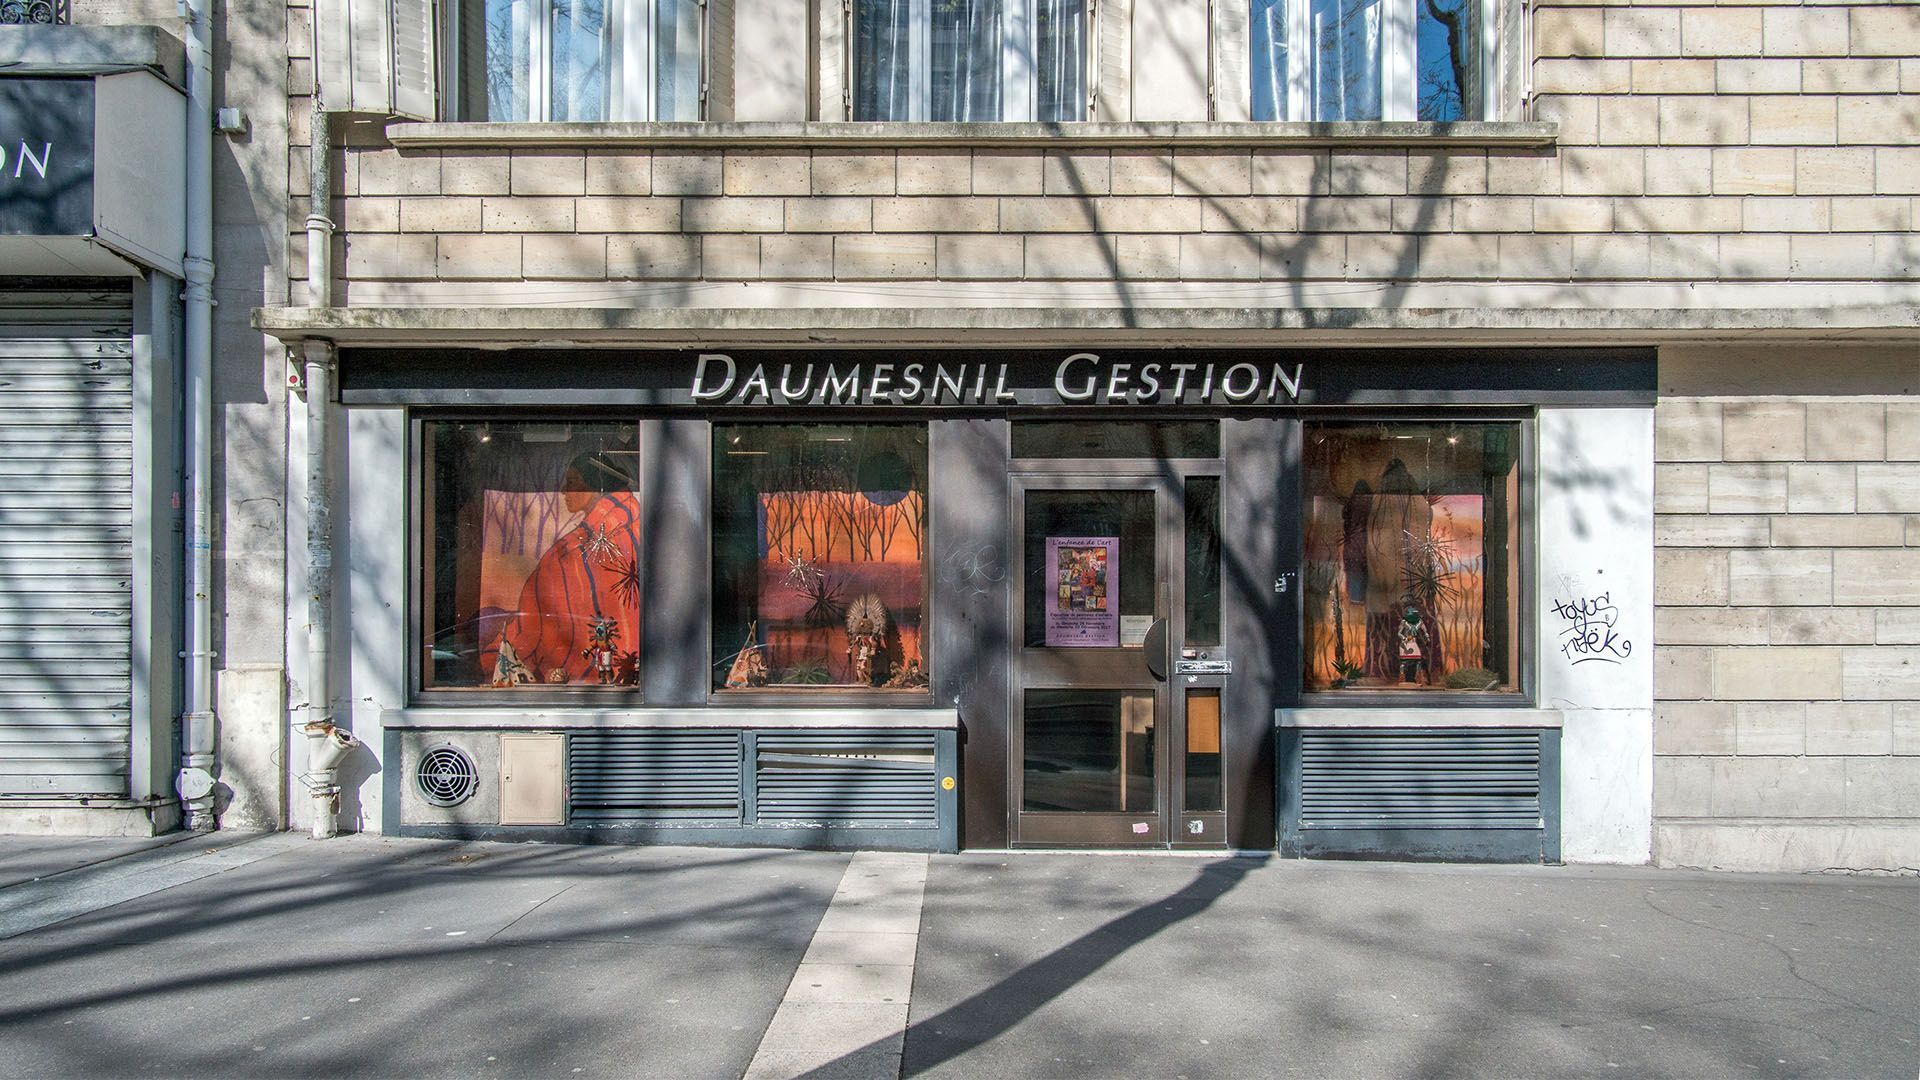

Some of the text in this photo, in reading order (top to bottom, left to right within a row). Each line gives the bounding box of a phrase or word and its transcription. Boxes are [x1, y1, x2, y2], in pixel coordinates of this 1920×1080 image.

[0, 142, 52, 178] N
[691, 353, 1304, 401] DAUMESNIL GESTION
